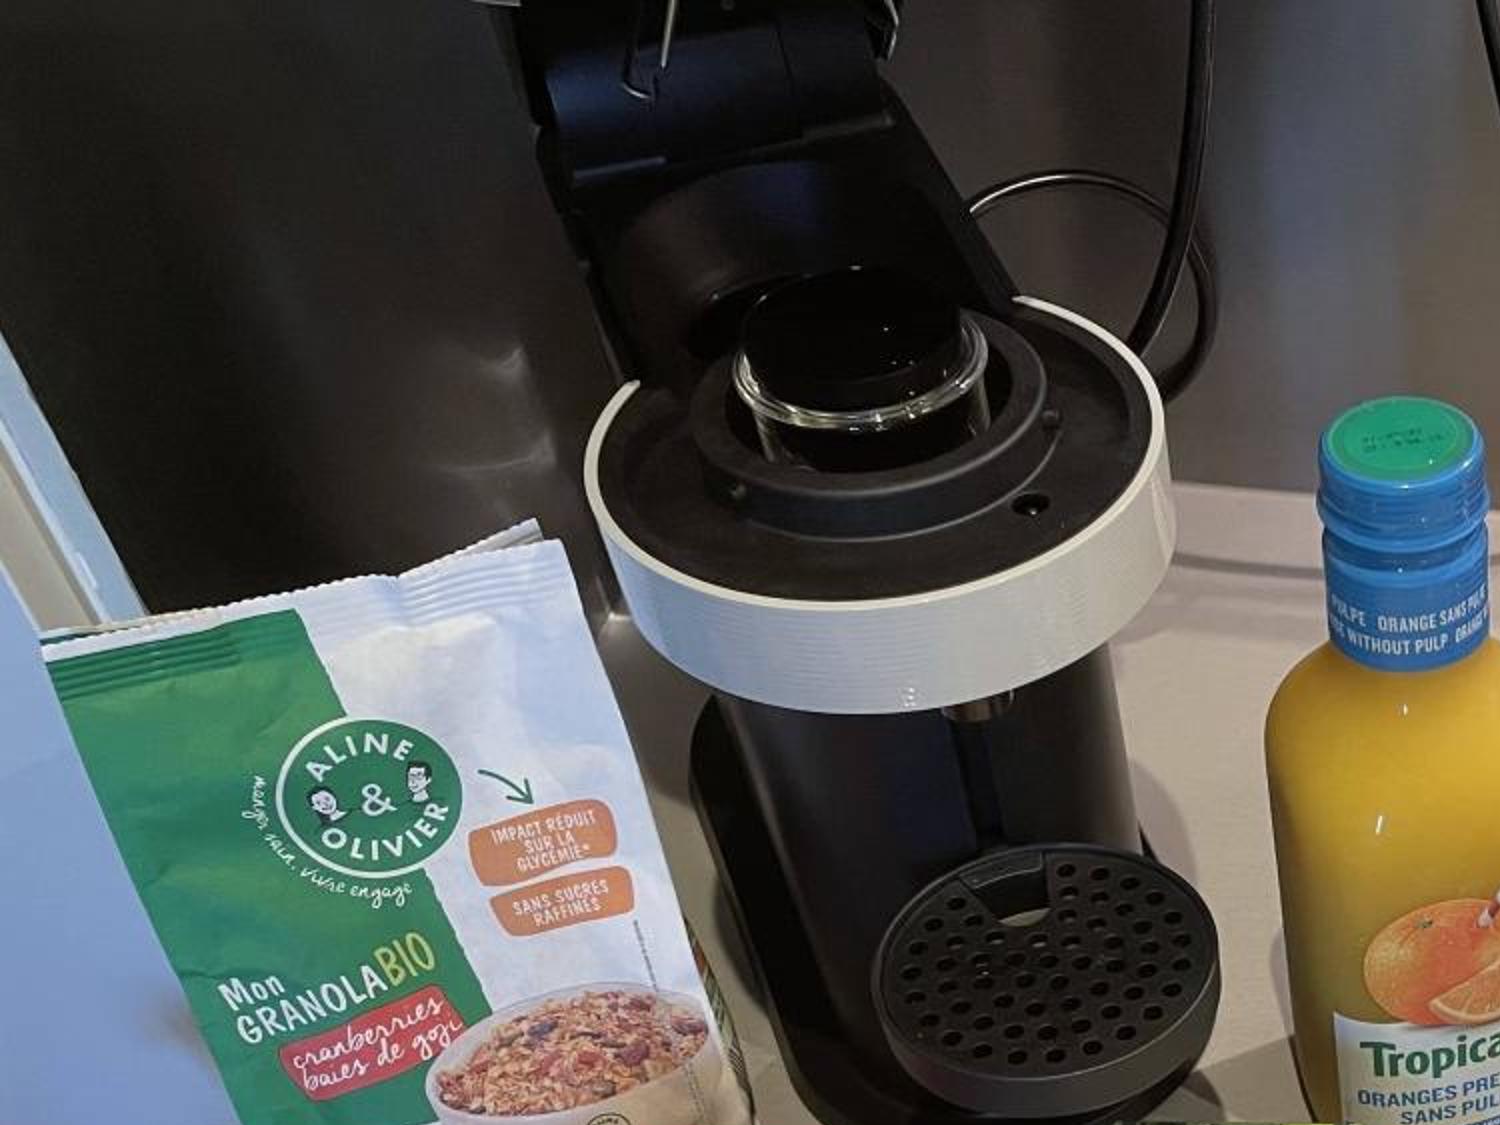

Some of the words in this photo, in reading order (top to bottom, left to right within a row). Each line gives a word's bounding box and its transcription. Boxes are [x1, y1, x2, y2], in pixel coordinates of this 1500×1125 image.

[1377, 613, 1437, 633] ORANGE
[1347, 628, 1411, 655] WITHOUT
[1415, 633, 1449, 653] PULP
[305, 733, 415, 782] ALINE
[361, 783, 398, 817] &
[321, 802, 449, 861] OLIVIER
[490, 822, 541, 846] IMPACT
[524, 836, 554, 853] SUR
[556, 831, 576, 846] LA
[512, 894, 551, 916] SANS
[554, 879, 609, 903] SUCRES
[217, 974, 285, 1012] Mon
[236, 964, 388, 1045] GRANOLA
[373, 931, 436, 987] BIO
[293, 996, 444, 1069] cranberries
[303, 1060, 369, 1093] baies
[377, 1036, 404, 1067] de
[411, 1019, 463, 1061] goji
[1357, 1084, 1458, 1108] ORANGES
[1400, 1102, 1457, 1125] SANS
